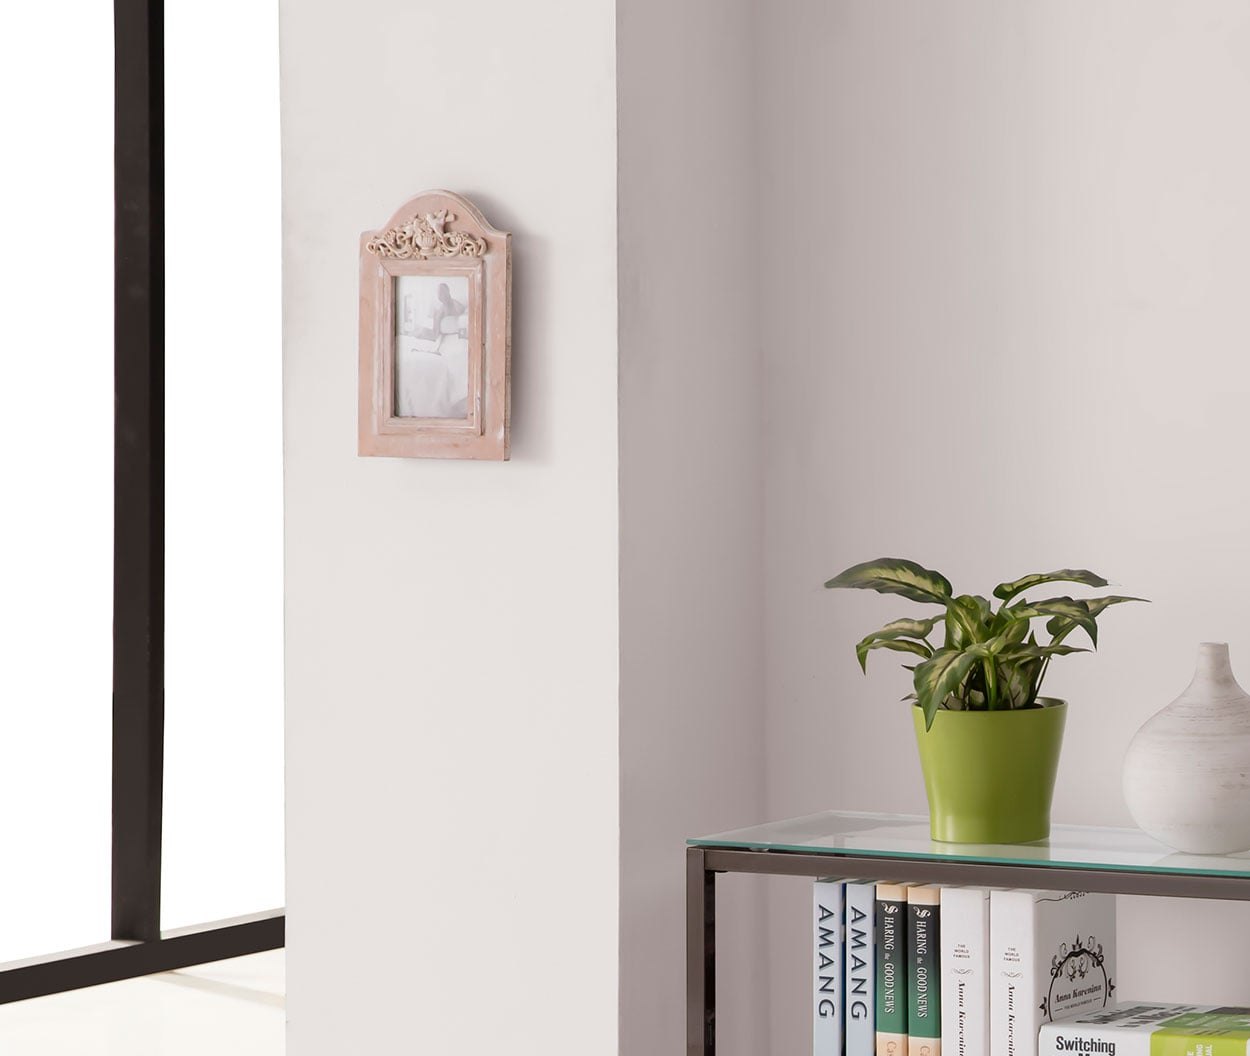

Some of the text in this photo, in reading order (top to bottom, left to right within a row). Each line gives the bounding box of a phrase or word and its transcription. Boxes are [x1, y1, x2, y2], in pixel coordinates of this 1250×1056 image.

[818, 904, 835, 1018] AMANG
[851, 906, 867, 1020] AMANG
[884, 963, 895, 988] GOOD
[917, 967, 928, 992] GOOD
[884, 989, 895, 1014] NEWS
[917, 993, 928, 1018] NEWS
[958, 979, 966, 1008] Anna
[1008, 983, 1016, 1011] Anna
[1056, 1036, 1116, 1056] Switching
